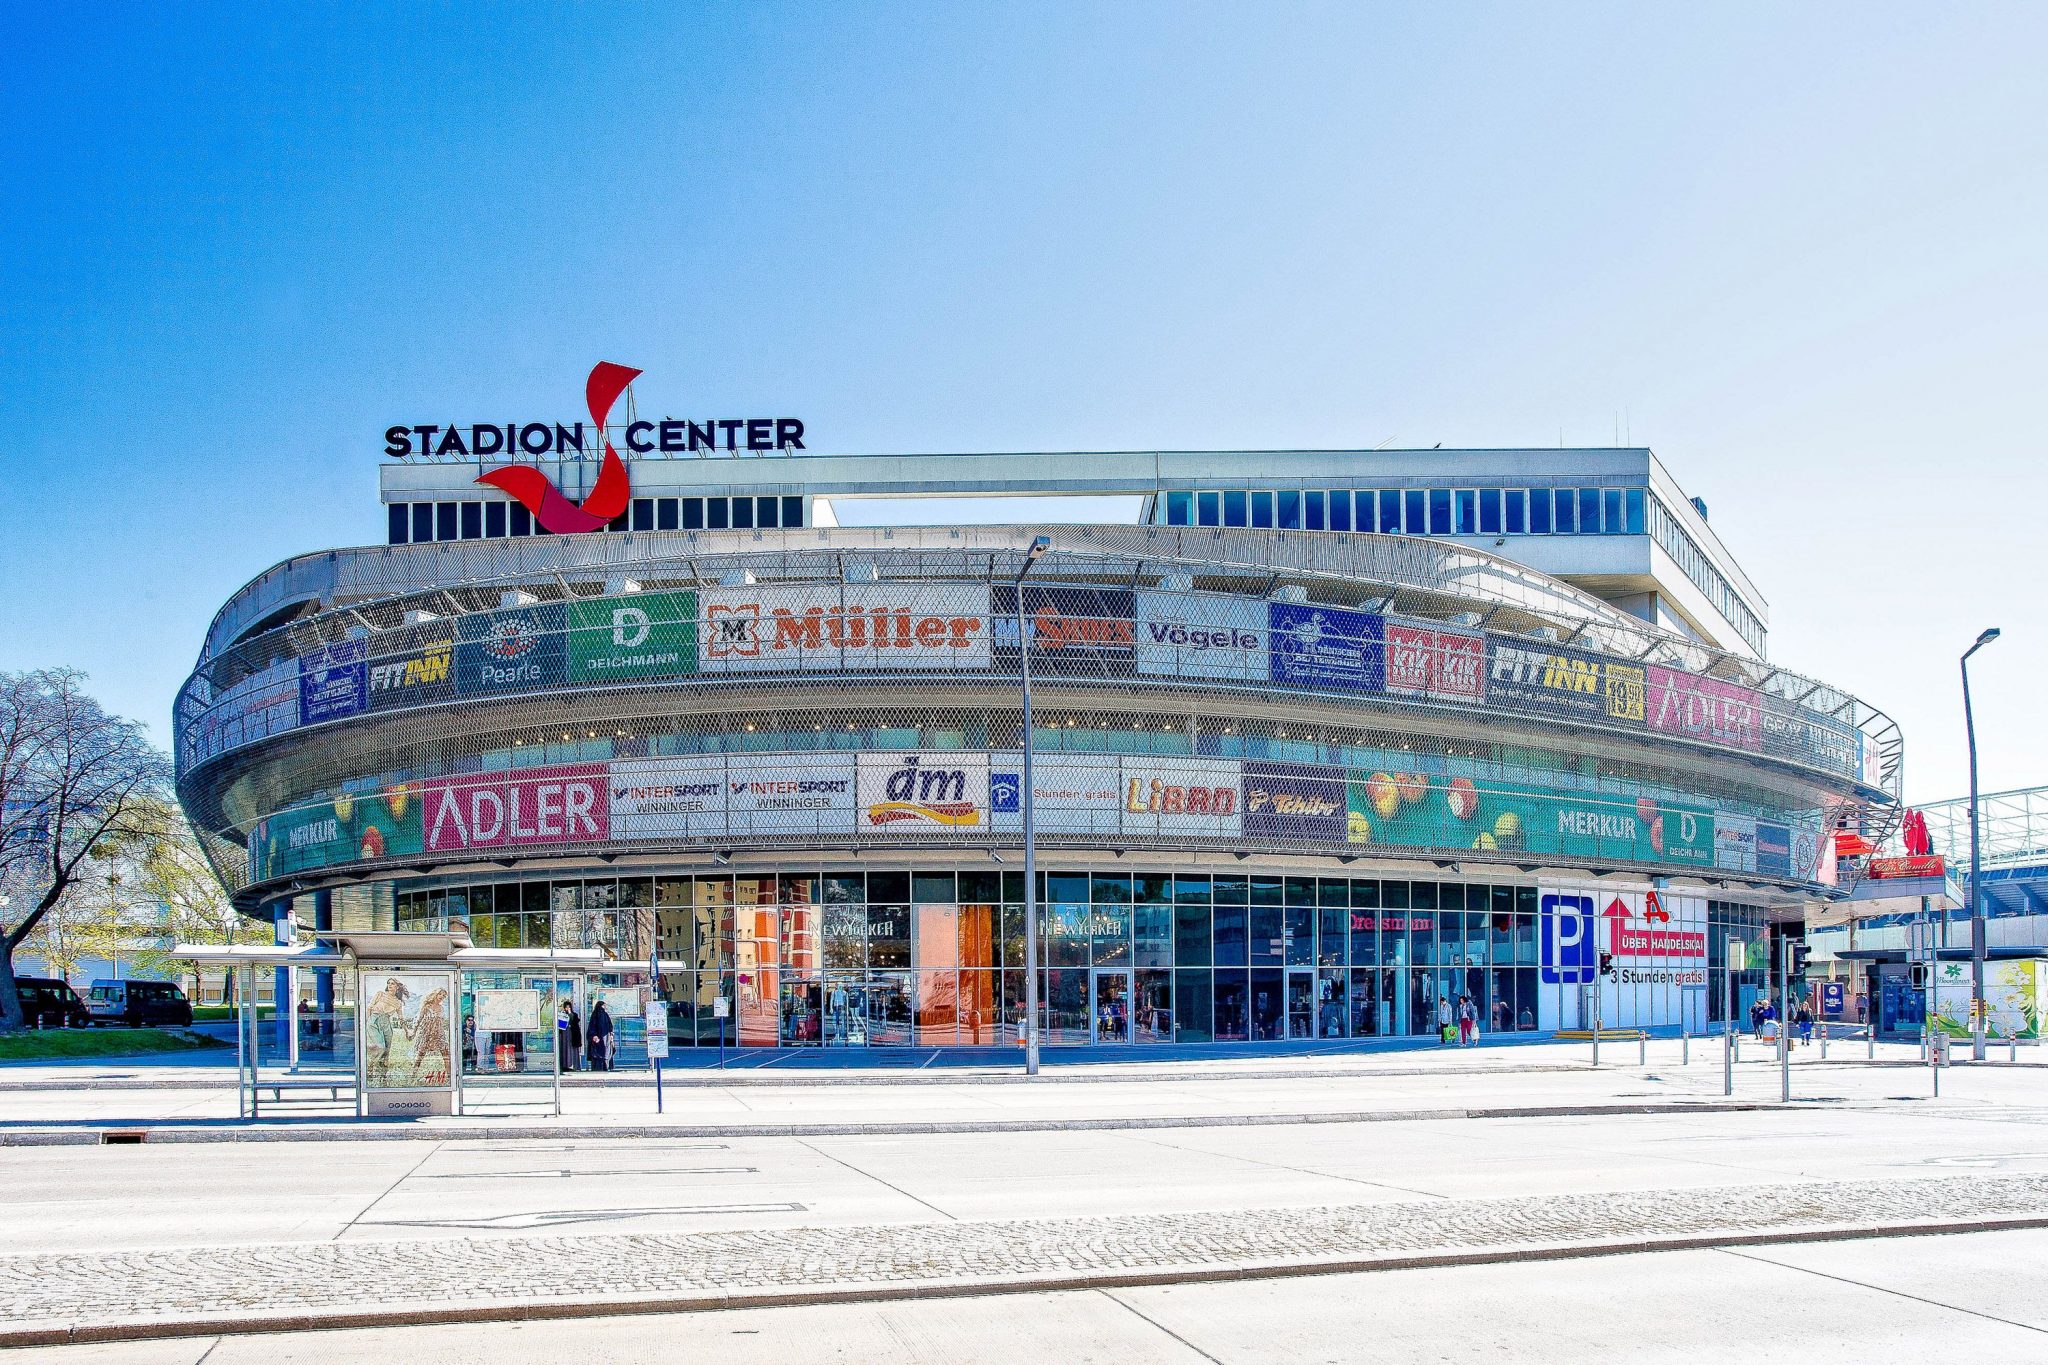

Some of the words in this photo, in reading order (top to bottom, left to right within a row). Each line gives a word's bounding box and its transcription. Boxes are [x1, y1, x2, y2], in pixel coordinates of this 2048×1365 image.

[384, 422, 583, 457] STADION
[625, 418, 806, 453] CENTER
[613, 607, 650, 647] D
[772, 606, 981, 650] Müller
[1149, 622, 1259, 650] Vögele
[588, 652, 679, 669] DEICHMANN
[481, 664, 541, 684] Pearle
[1655, 674, 1752, 746] ADLER
[750, 780, 848, 795] INTERSPORT
[886, 757, 967, 801] dm
[630, 784, 719, 799] INTERSPORT
[757, 798, 831, 809] WINNINGER
[1034, 789, 1081, 799] Stunden
[1085, 790, 1116, 801] gratis
[428, 782, 600, 850] ADLER
[636, 801, 704, 813] WINNINGER
[289, 819, 337, 847] MERKUR
[1558, 810, 1636, 839] MERKUR
[1680, 813, 1696, 843] D
[1899, 859, 1937, 870] Camillo
[1350, 913, 1434, 931] Dresmann
[1552, 905, 1584, 973] P
[1622, 937, 1647, 949] ÜBER
[1651, 937, 1703, 950] HANDELSKAI
[1610, 971, 1618, 983] 3
[1622, 969, 1674, 983] Stunden
[1675, 971, 1706, 986] gratis!
